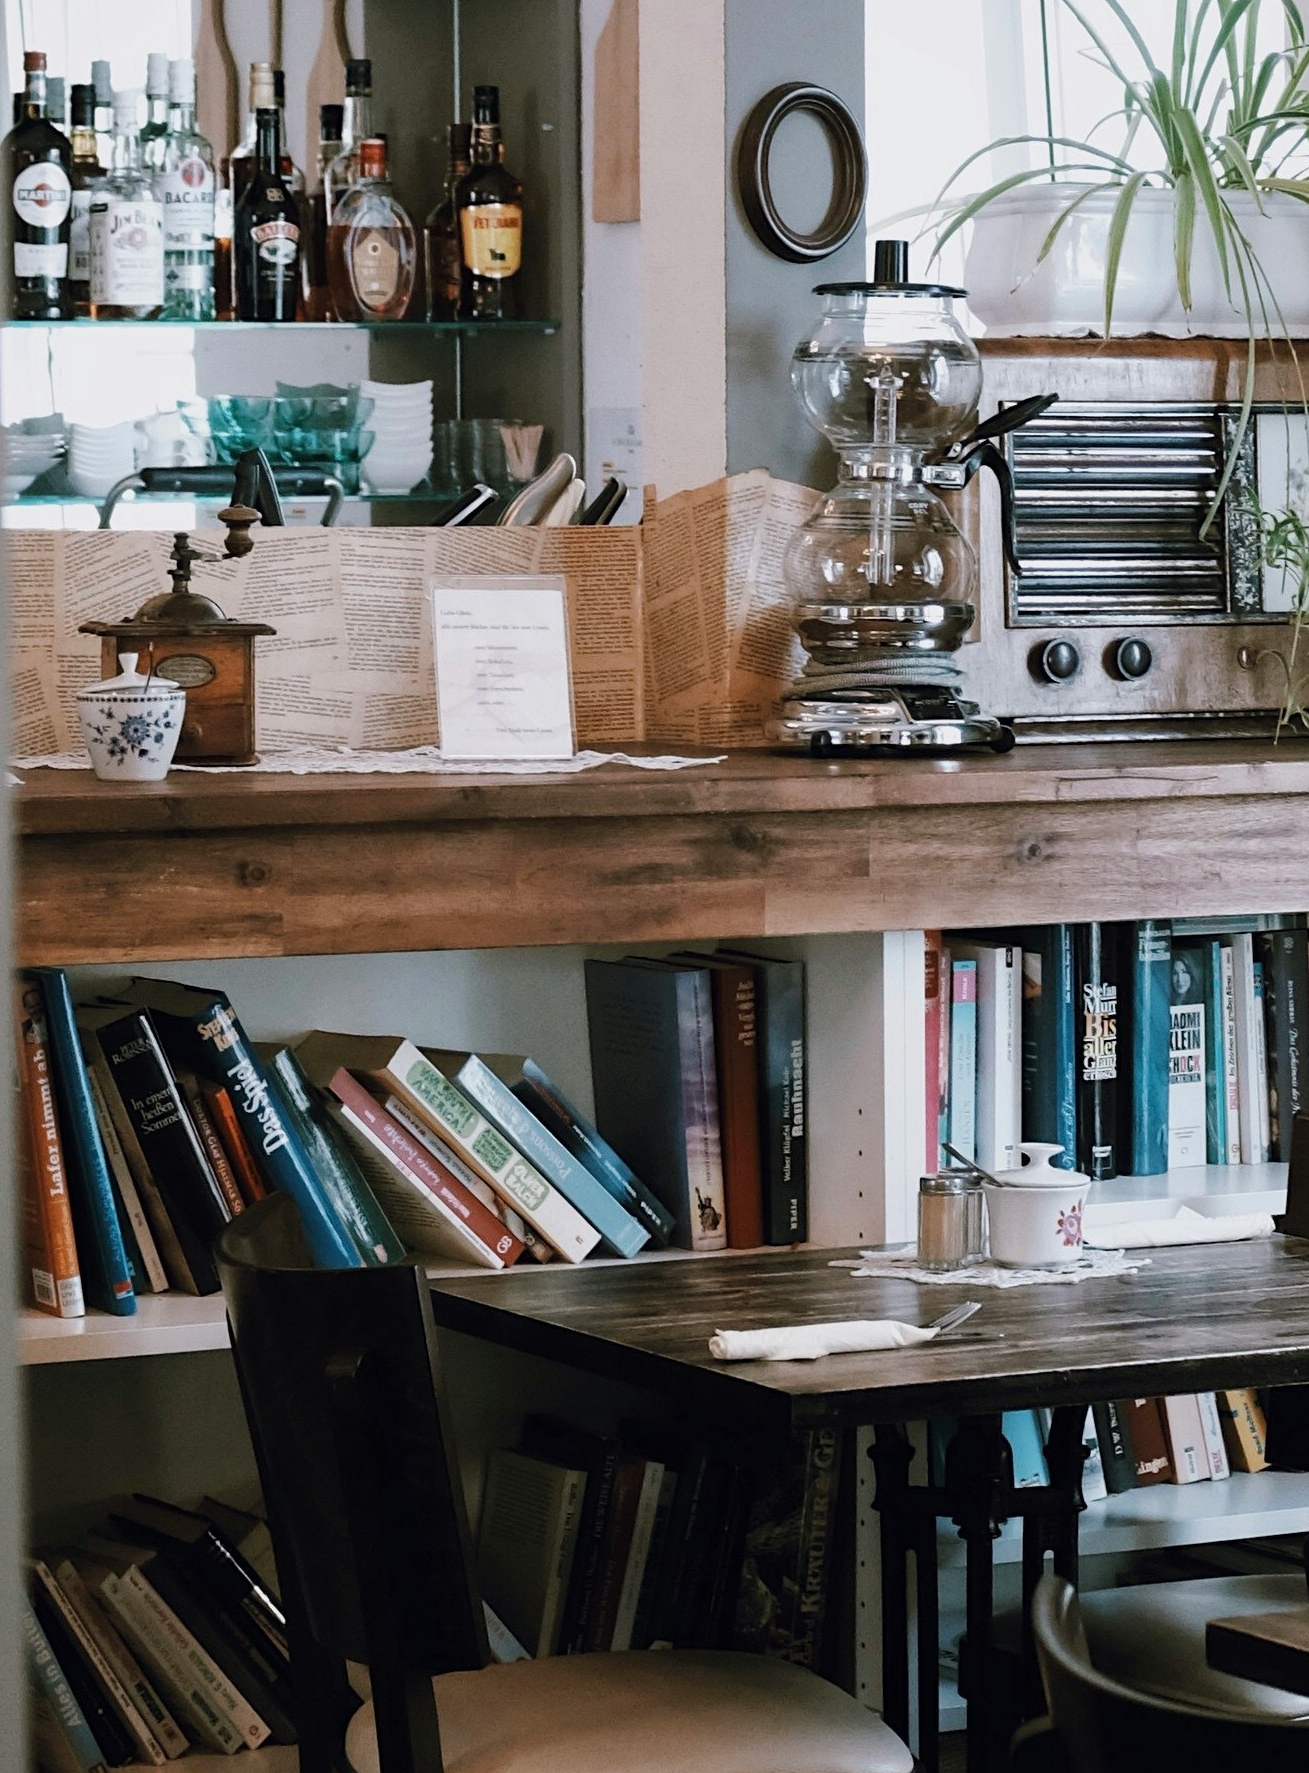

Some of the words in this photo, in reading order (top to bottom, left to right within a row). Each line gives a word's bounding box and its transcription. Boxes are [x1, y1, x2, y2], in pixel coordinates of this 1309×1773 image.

[165, 191, 214, 204] BACARD
[1083, 983, 1117, 999] Stefan
[1083, 998, 1117, 1015] Murr
[1085, 1013, 1117, 1038] Bis
[1170, 1011, 1201, 1030] AOMI
[1083, 1038, 1117, 1057] aller
[33, 1050, 45, 1072] ab
[227, 1058, 269, 1114] Spiel
[791, 1039, 803, 1137] Rauhnacht
[42, 1077, 58, 1140] nimmt
[132, 1097, 143, 1112] In
[142, 1102, 175, 1122] heißen
[257, 1107, 289, 1156] Das
[47, 1145, 64, 1197] Lafer
[509, 1160, 549, 1198] OLIVER
[44, 1663, 61, 1683] in
[54, 1682, 83, 1728] Alles
